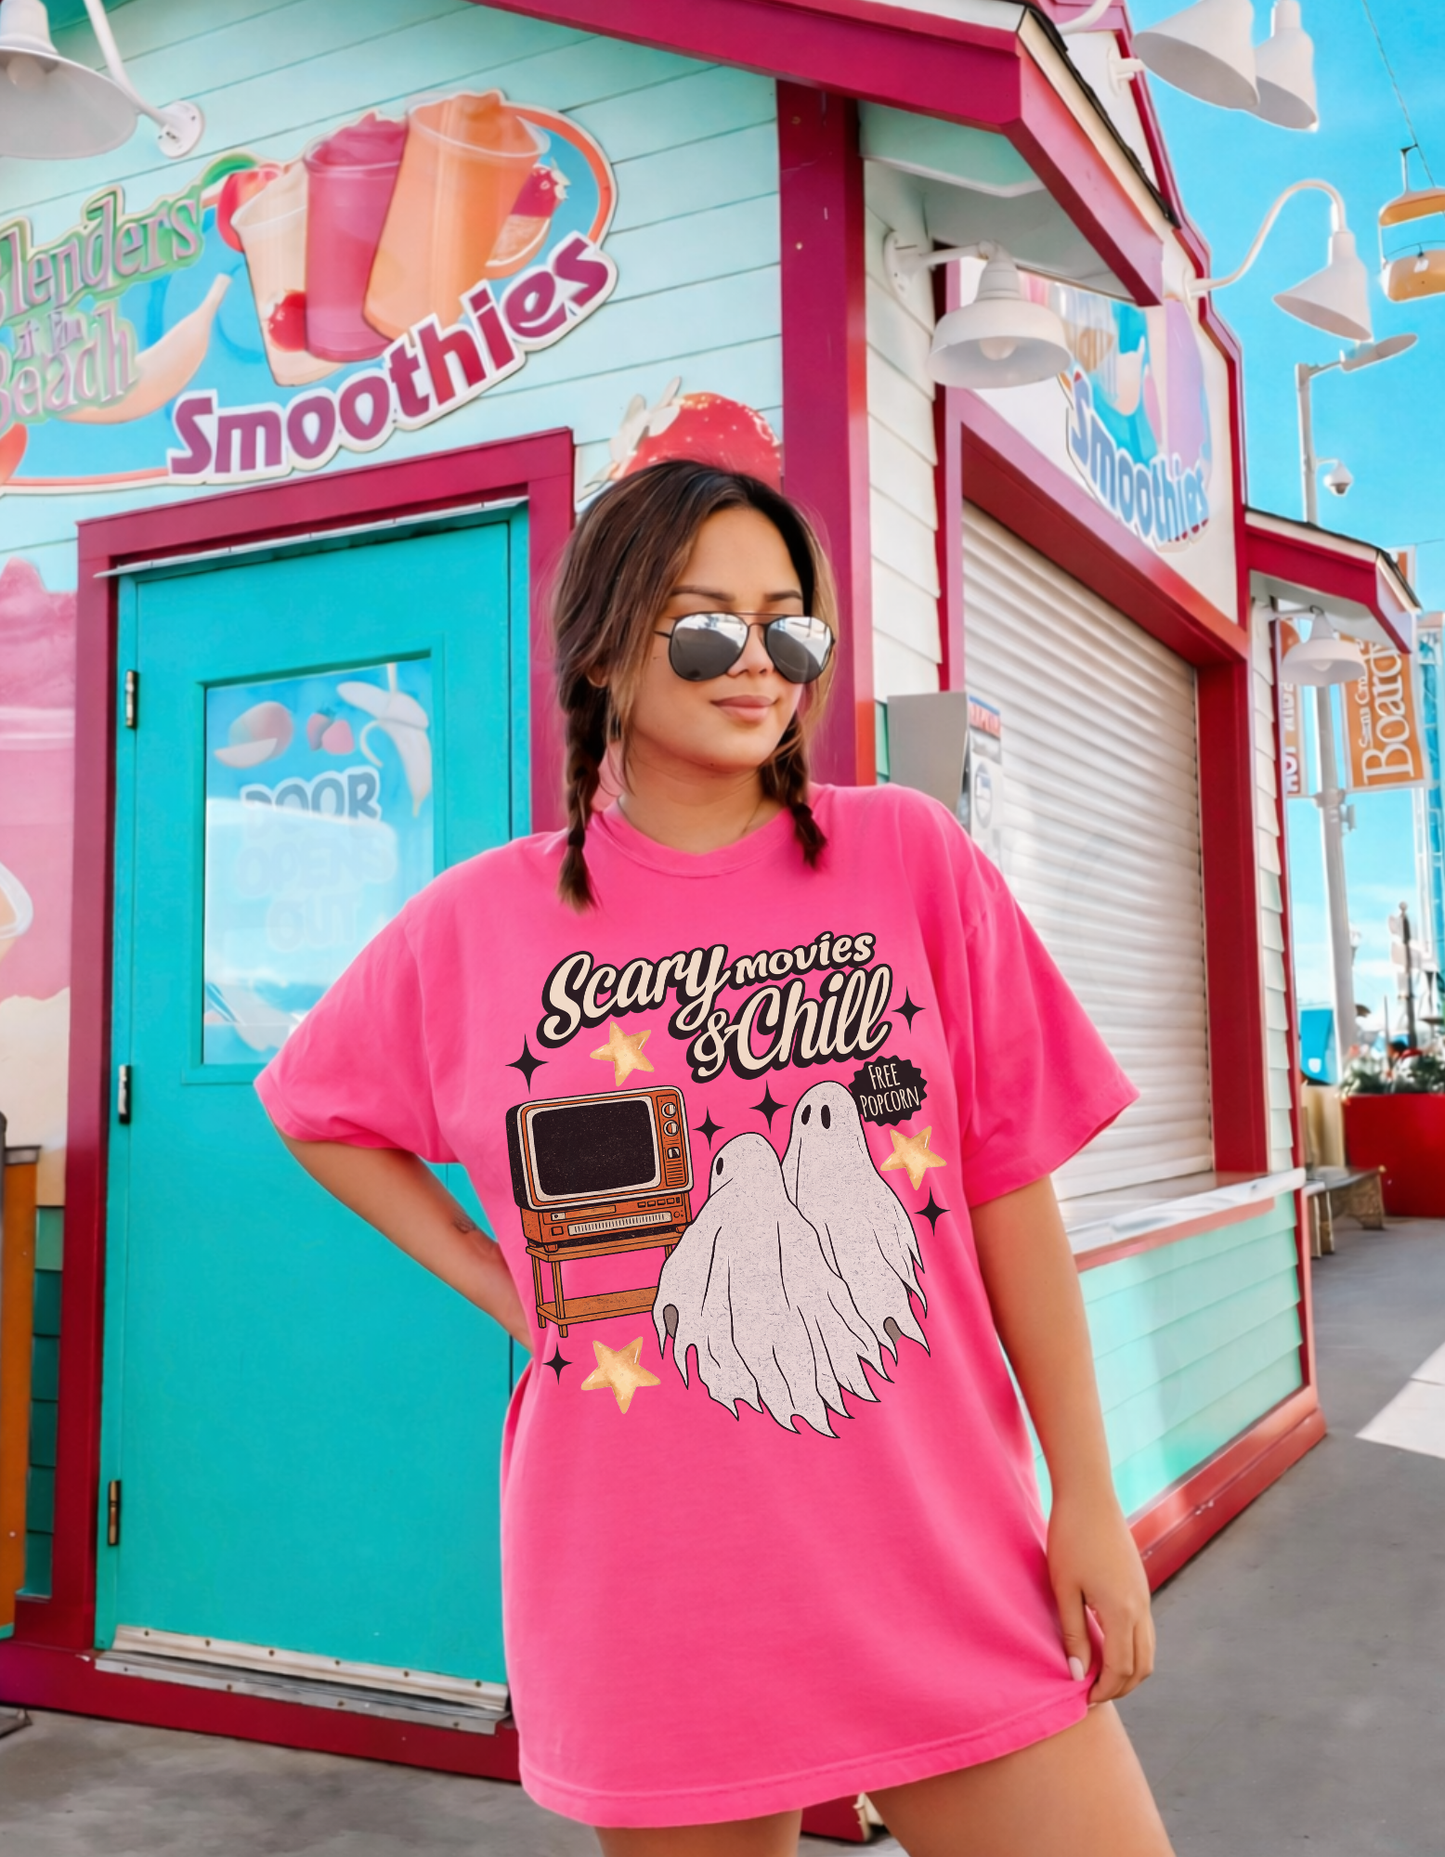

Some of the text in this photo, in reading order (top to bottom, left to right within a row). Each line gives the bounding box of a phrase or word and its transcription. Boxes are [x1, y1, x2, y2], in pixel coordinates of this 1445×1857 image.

[0, 199, 198, 318] lenders
[168, 234, 612, 477] Smoothies
[1360, 644, 1415, 786] Board
[244, 770, 382, 838] DOOR
[540, 932, 875, 1044] Scary movies
[859, 1085, 920, 1118] POPCORN
[867, 1063, 901, 1091] FREE
